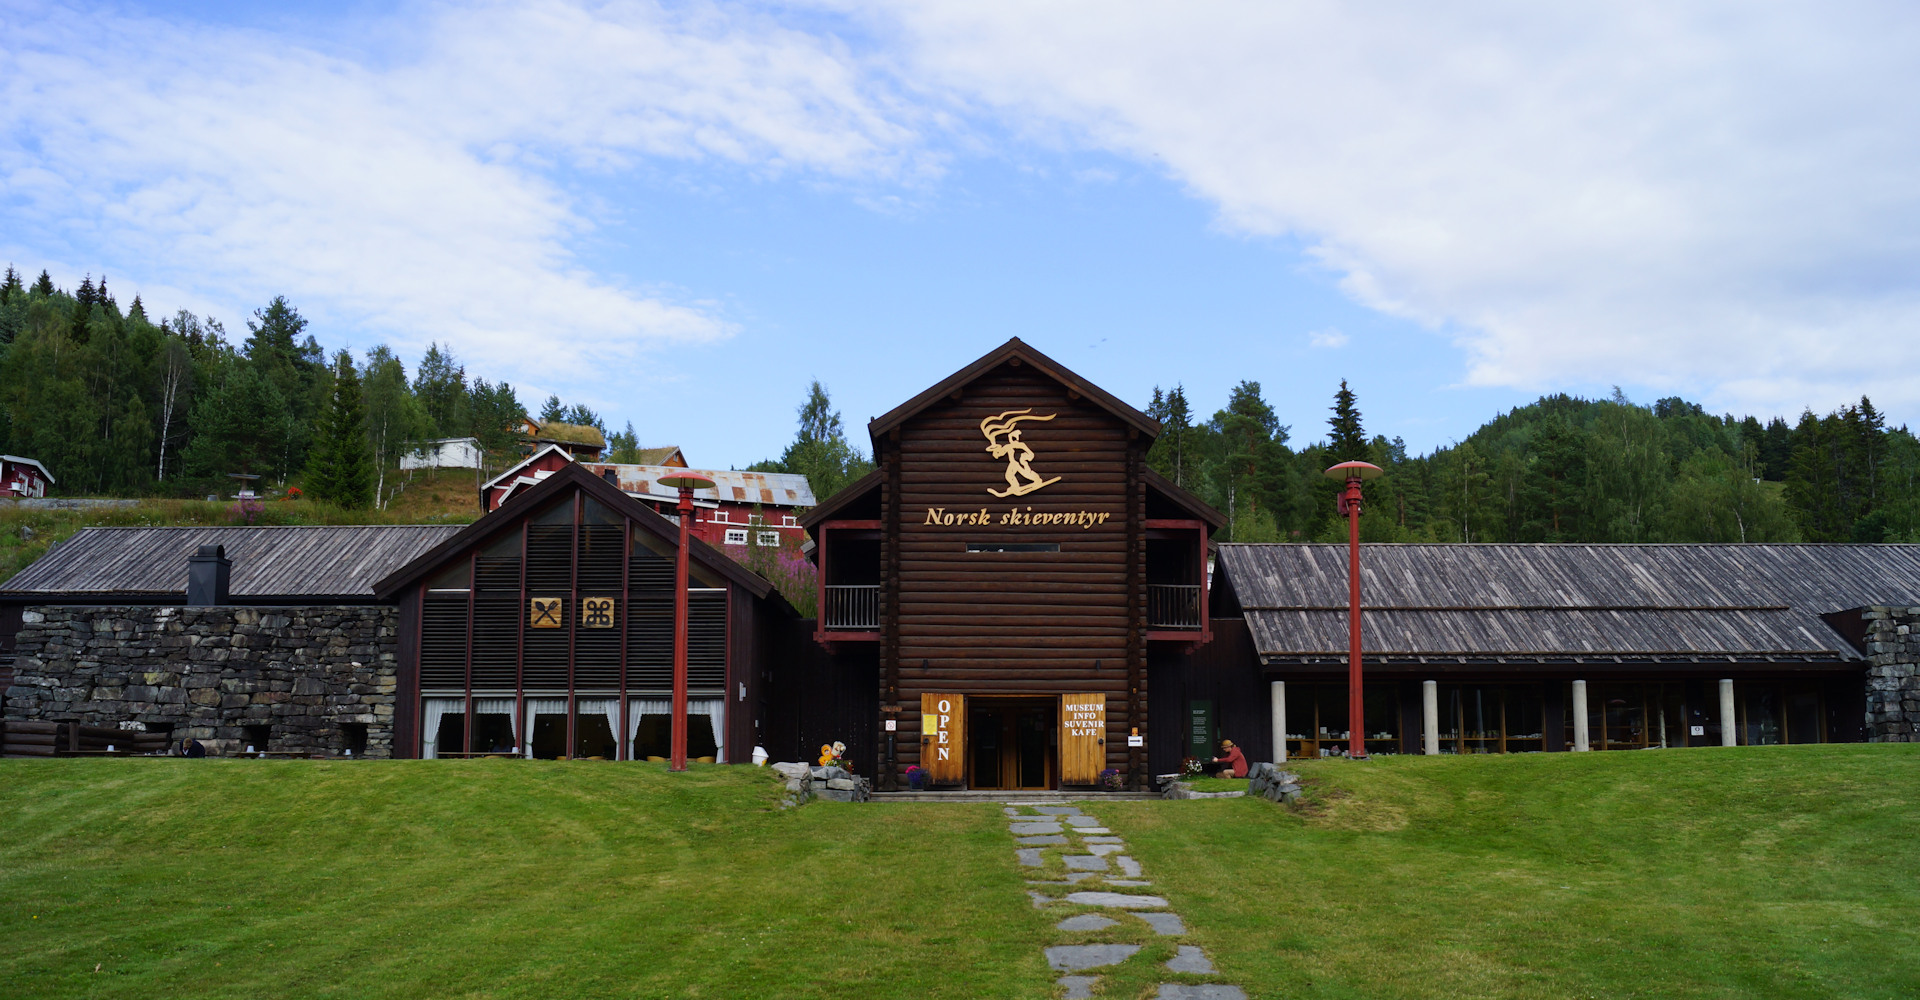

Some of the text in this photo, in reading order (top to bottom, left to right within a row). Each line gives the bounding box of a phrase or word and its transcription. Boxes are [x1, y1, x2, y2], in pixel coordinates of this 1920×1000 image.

[923, 506, 1110, 530] Norsk skieventyr
[1065, 703, 1104, 712] MUSEUM
[1073, 712, 1096, 720] INFO
[1064, 720, 1105, 728] SUVENIR
[937, 699, 951, 761] OPEN
[1071, 728, 1097, 736] KAFE
